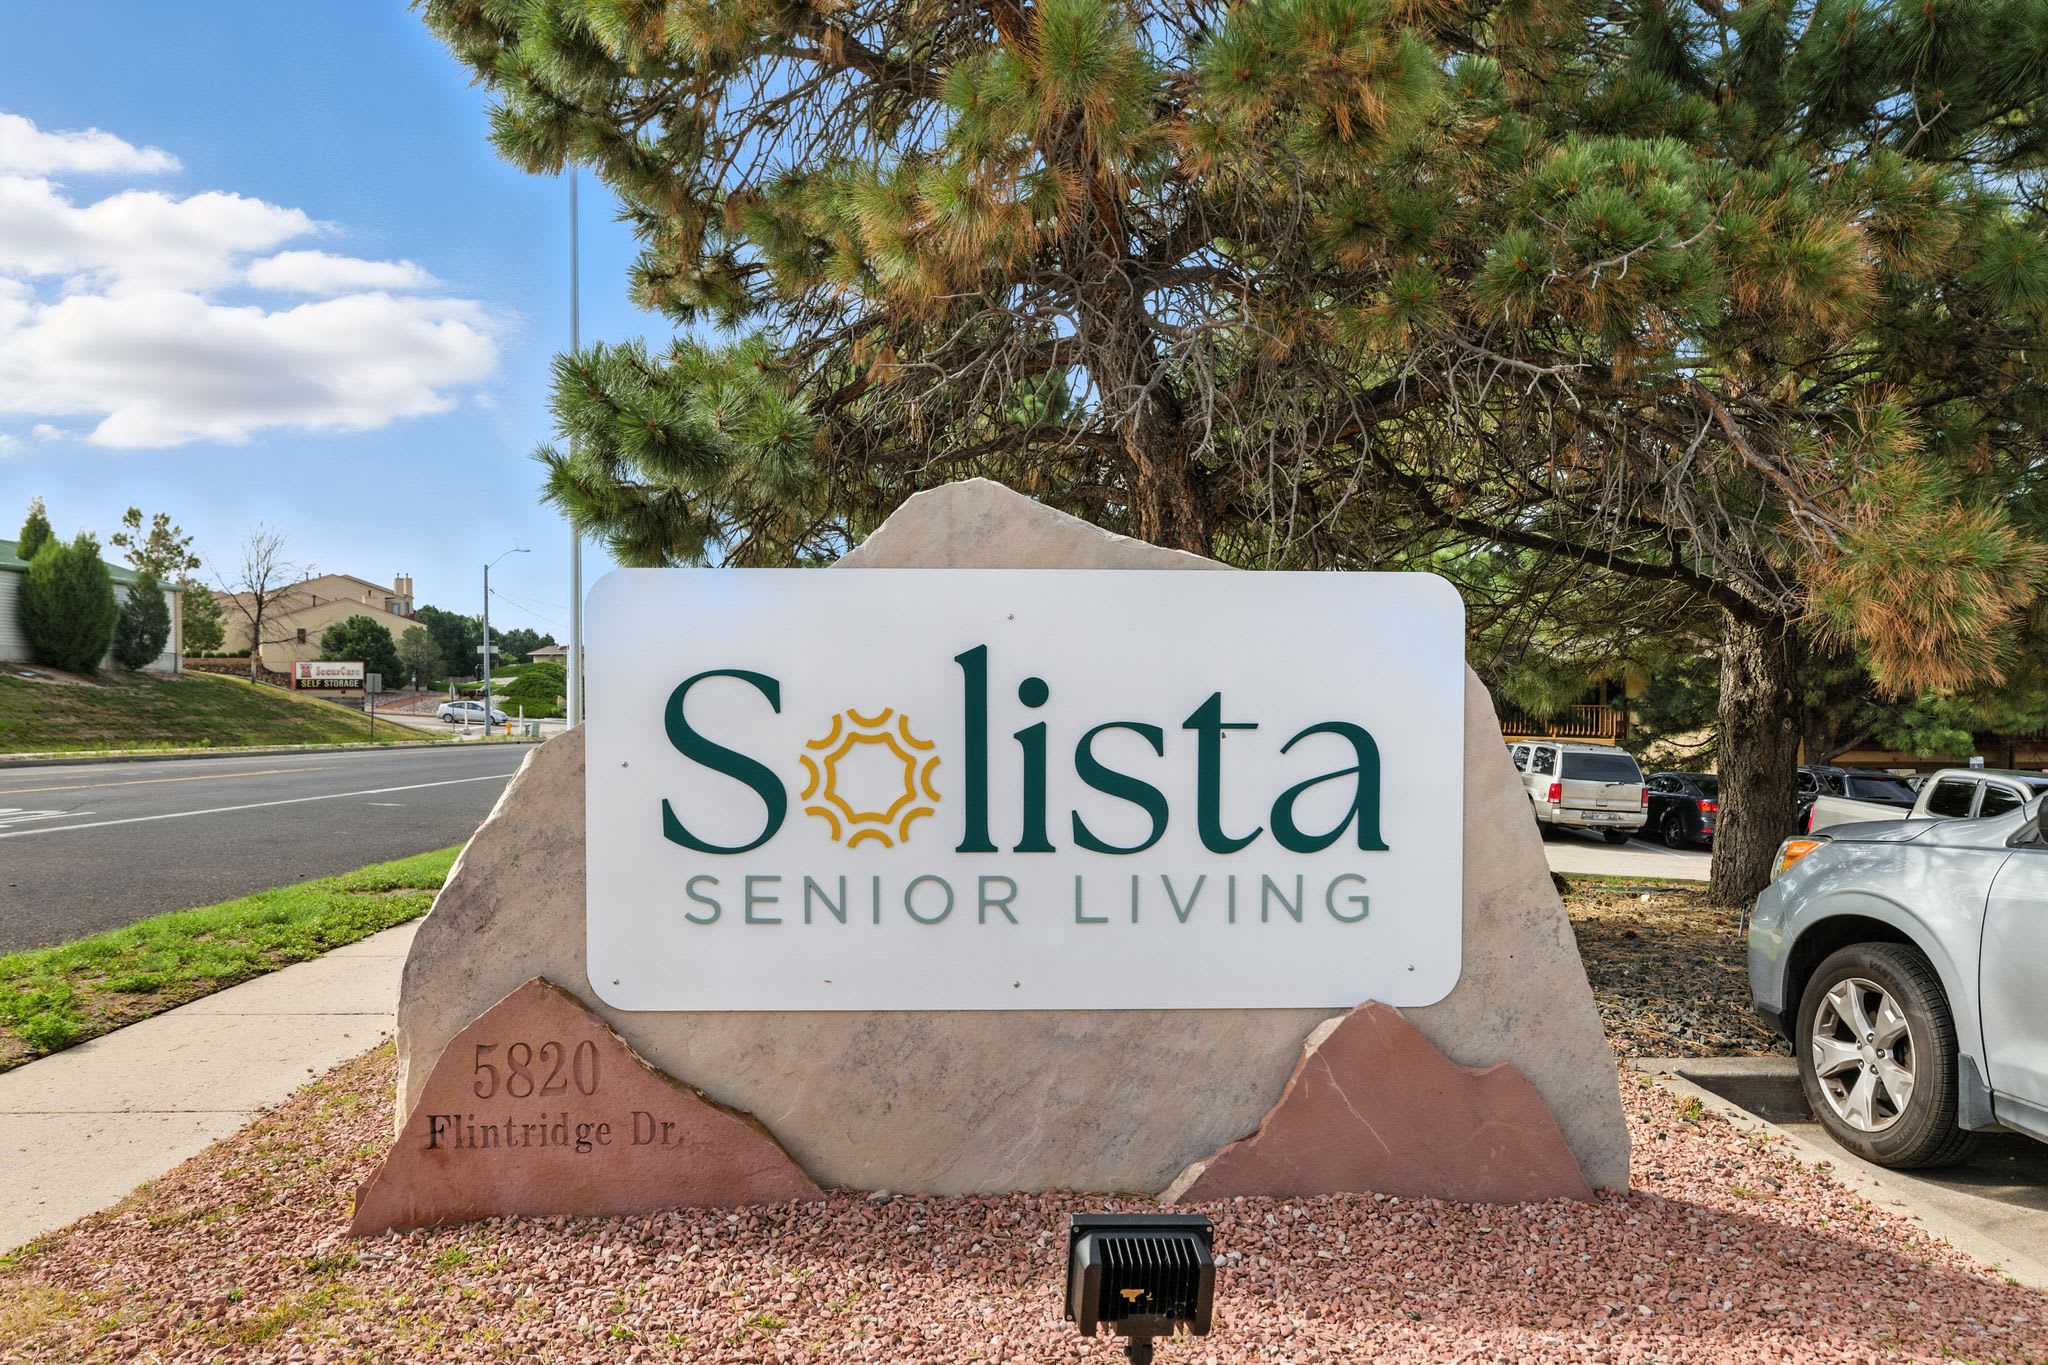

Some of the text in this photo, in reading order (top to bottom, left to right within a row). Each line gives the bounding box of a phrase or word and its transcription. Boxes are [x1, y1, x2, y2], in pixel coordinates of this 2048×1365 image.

[301, 680, 359, 688] SELF STORAGE
[685, 874, 1370, 926] SENIOR LIVING
[473, 1040, 600, 1099] 5820
[426, 1112, 613, 1154] Flintridge
